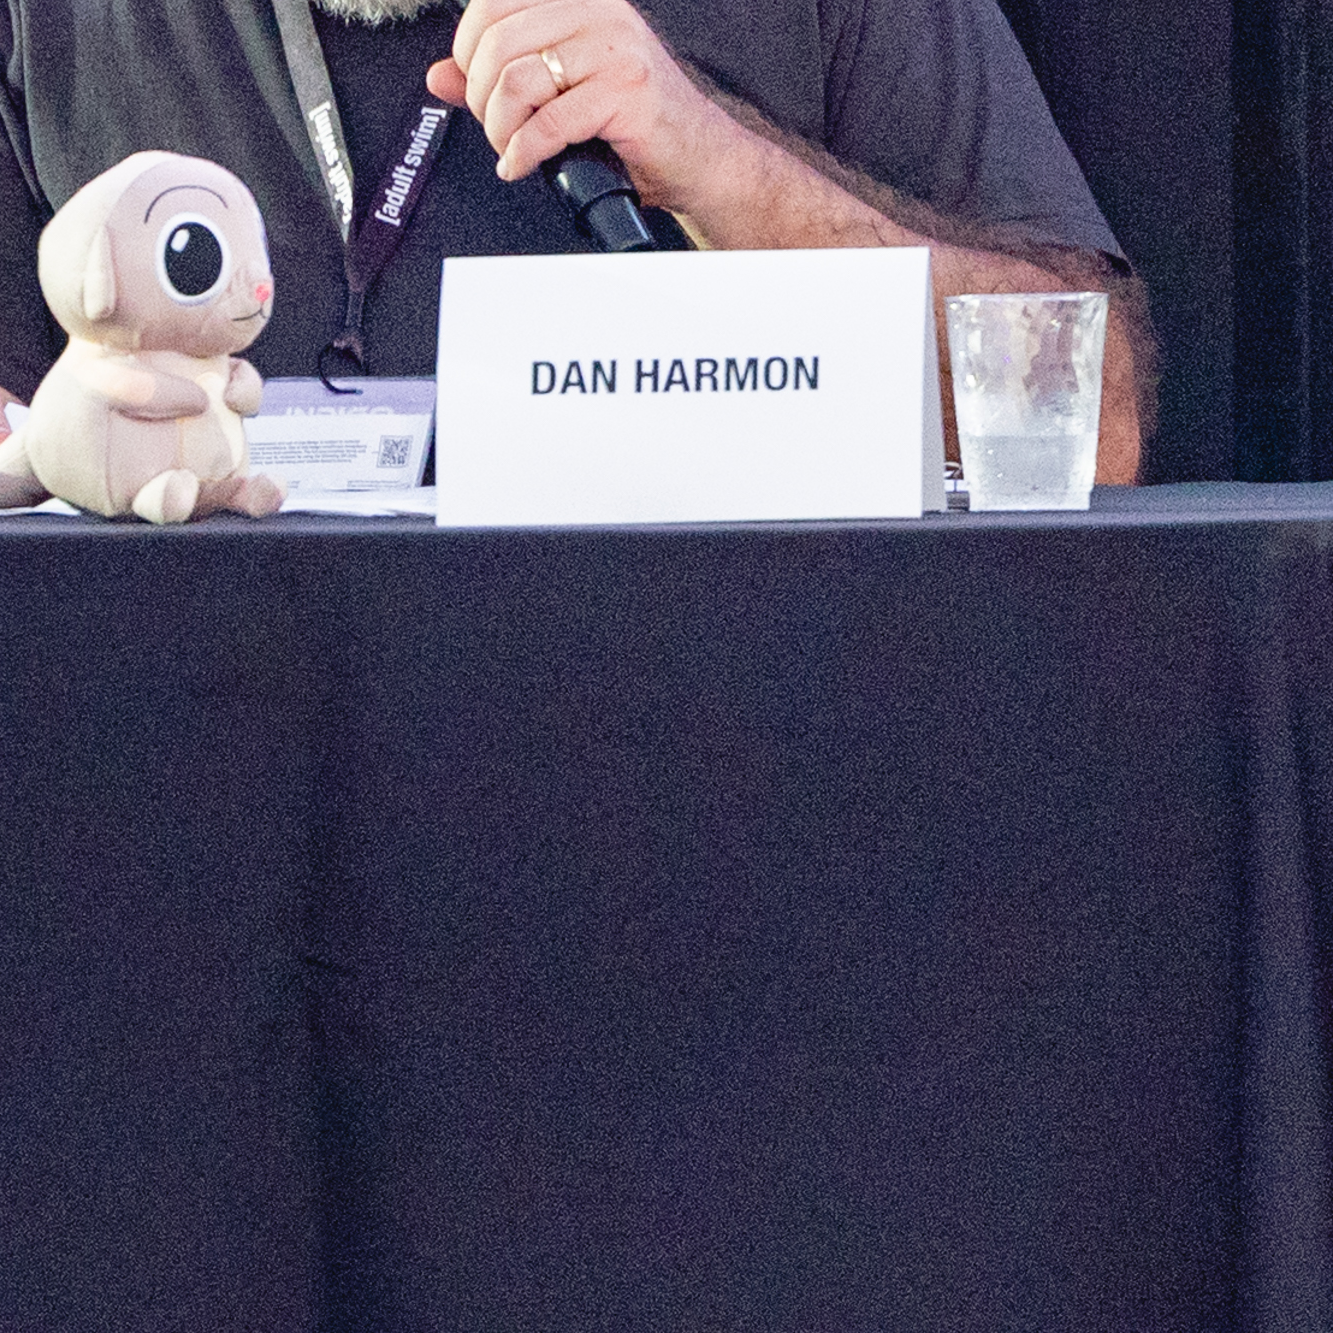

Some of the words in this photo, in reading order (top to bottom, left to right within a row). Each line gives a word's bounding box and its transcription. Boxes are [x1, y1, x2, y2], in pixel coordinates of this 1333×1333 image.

[308, 101, 340, 166] swim]
[374, 165, 416, 227] [adult
[403, 106, 447, 167] swim]
[530, 358, 618, 396] DAN
[634, 355, 821, 394] HARMON
